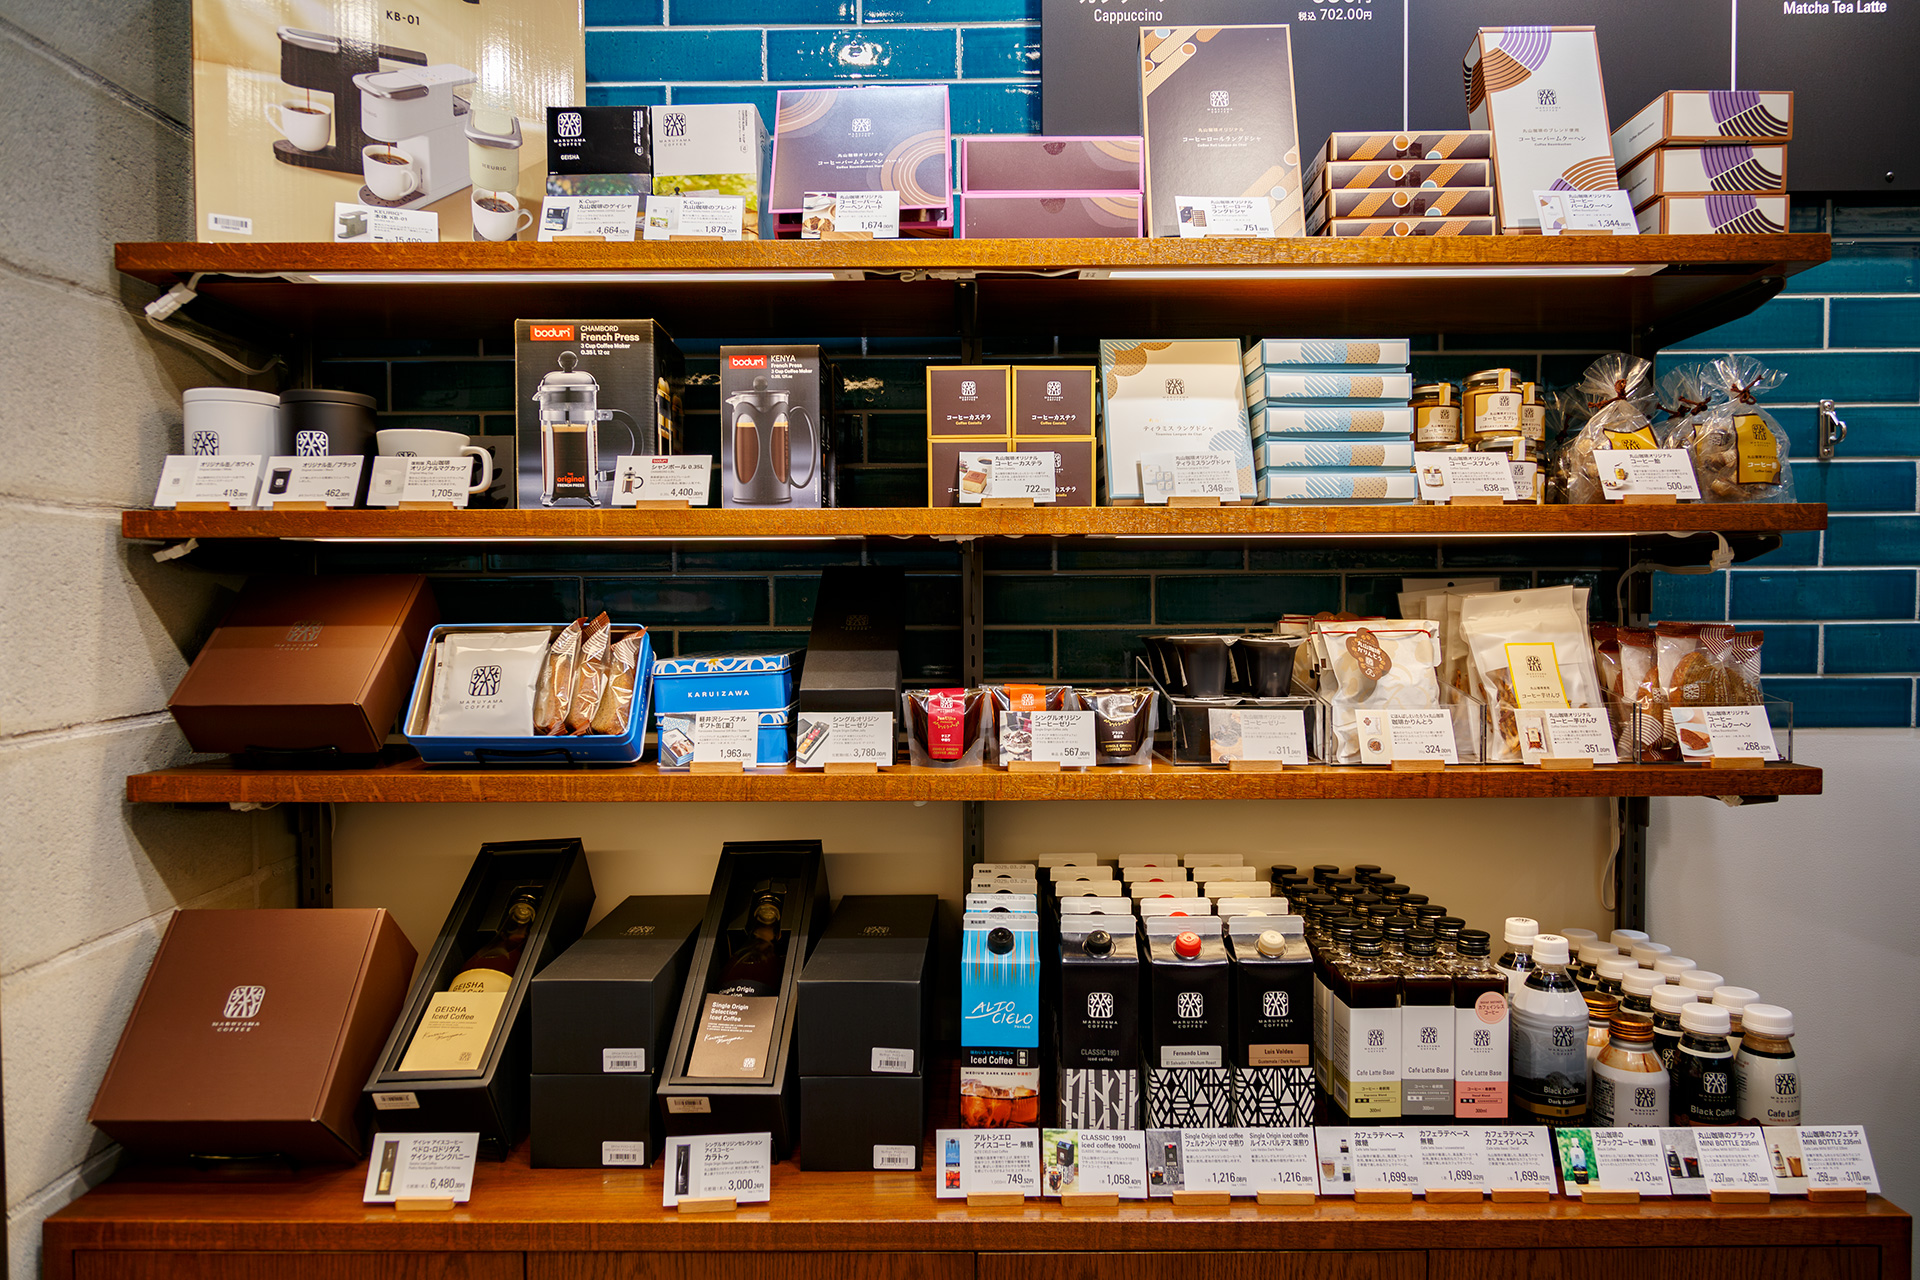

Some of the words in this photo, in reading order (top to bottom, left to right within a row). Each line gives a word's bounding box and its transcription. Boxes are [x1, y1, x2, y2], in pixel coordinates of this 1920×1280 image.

[1783, 1, 1829, 14] Matcha
[1832, 1, 1853, 14] Tea
[1857, 0, 1887, 14] Latte
[386, 10, 420, 26] KB-01
[1094, 9, 1163, 24] Cappuccino
[1298, 11, 1317, 21] 税込
[1320, 8, 1372, 21] 702.00円
[534, 328, 570, 337] bodum
[581, 333, 613, 341] French
[614, 333, 640, 341] Press
[733, 357, 763, 366] bodum
[557, 475, 585, 483] original
[1357, 647, 1382, 662] かりんとう
[687, 689, 749, 698] KARUIZAWA
[992, 1013, 1033, 1025] CIELO
[970, 1056, 987, 1065] Iced
[989, 1056, 1013, 1065] Coffee
[1544, 1086, 1561, 1095] Black
[1563, 1087, 1579, 1095] Coffee
[1691, 1105, 1714, 1116] Black
[1716, 1109, 1736, 1117] Coffee
[1249, 1132, 1265, 1140] Single
[1266, 1132, 1281, 1140] Origin
[705, 1140, 762, 1148] シングルオリジンセレクション
[1118, 1142, 1141, 1150] 1000ml
[1486, 1138, 1529, 1146] カフェインレス
[410, 1153, 433, 1161] ゲイシャ
